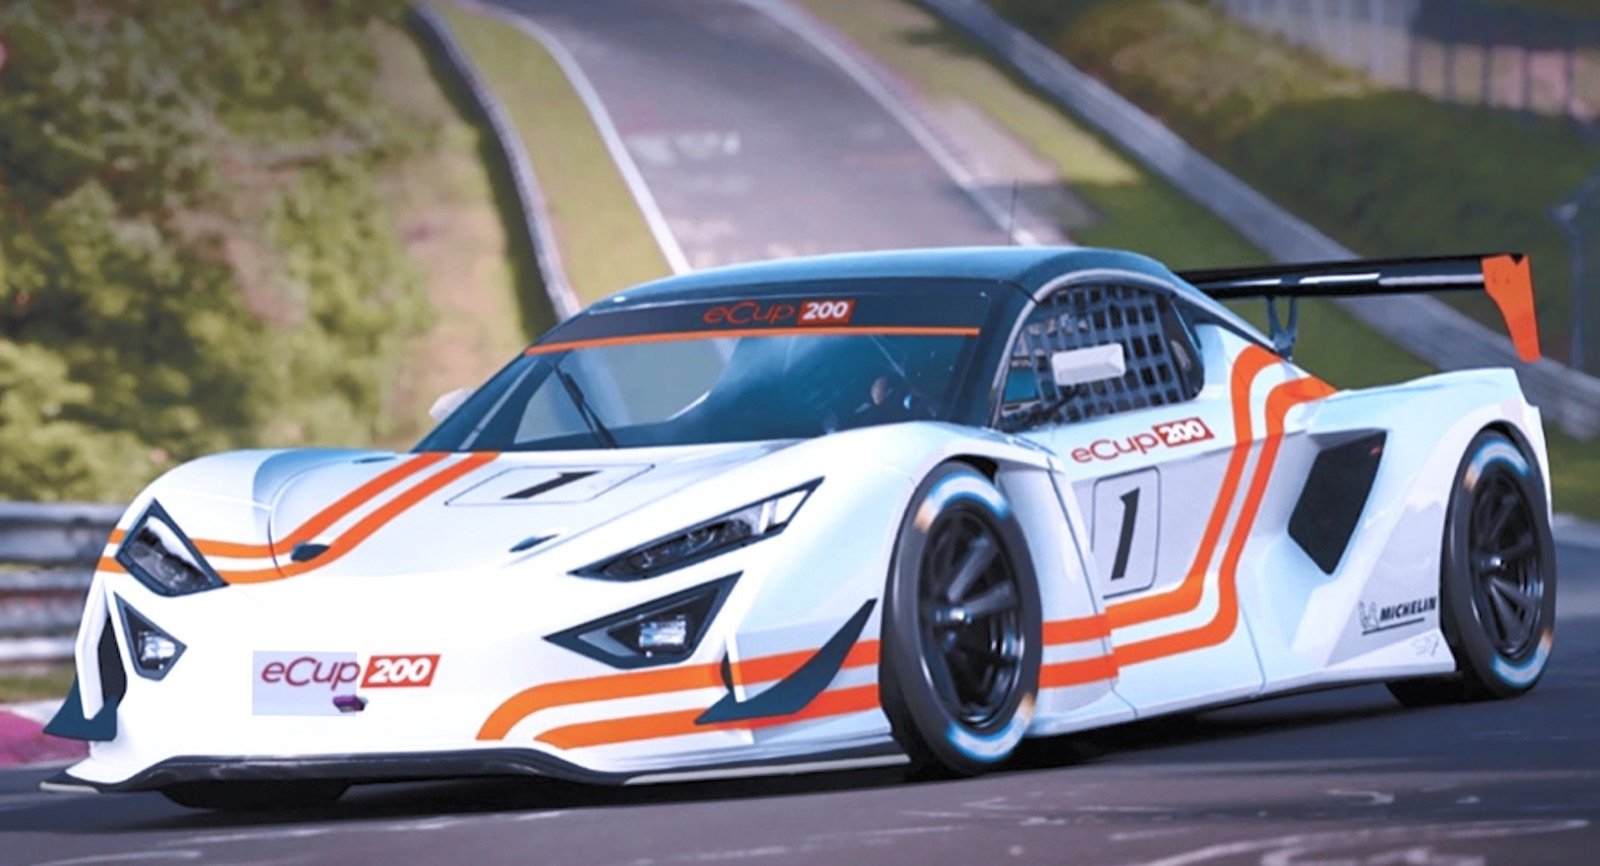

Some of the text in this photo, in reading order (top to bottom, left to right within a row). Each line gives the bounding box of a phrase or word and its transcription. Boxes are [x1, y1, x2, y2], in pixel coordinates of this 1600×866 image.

[703, 301, 849, 324] eCup 200
[1071, 420, 1206, 463] eCup 200
[500, 470, 602, 500] 1
[1109, 486, 1141, 580] 1
[1380, 596, 1437, 621] MICHELIN
[261, 656, 433, 691] eCup 200
